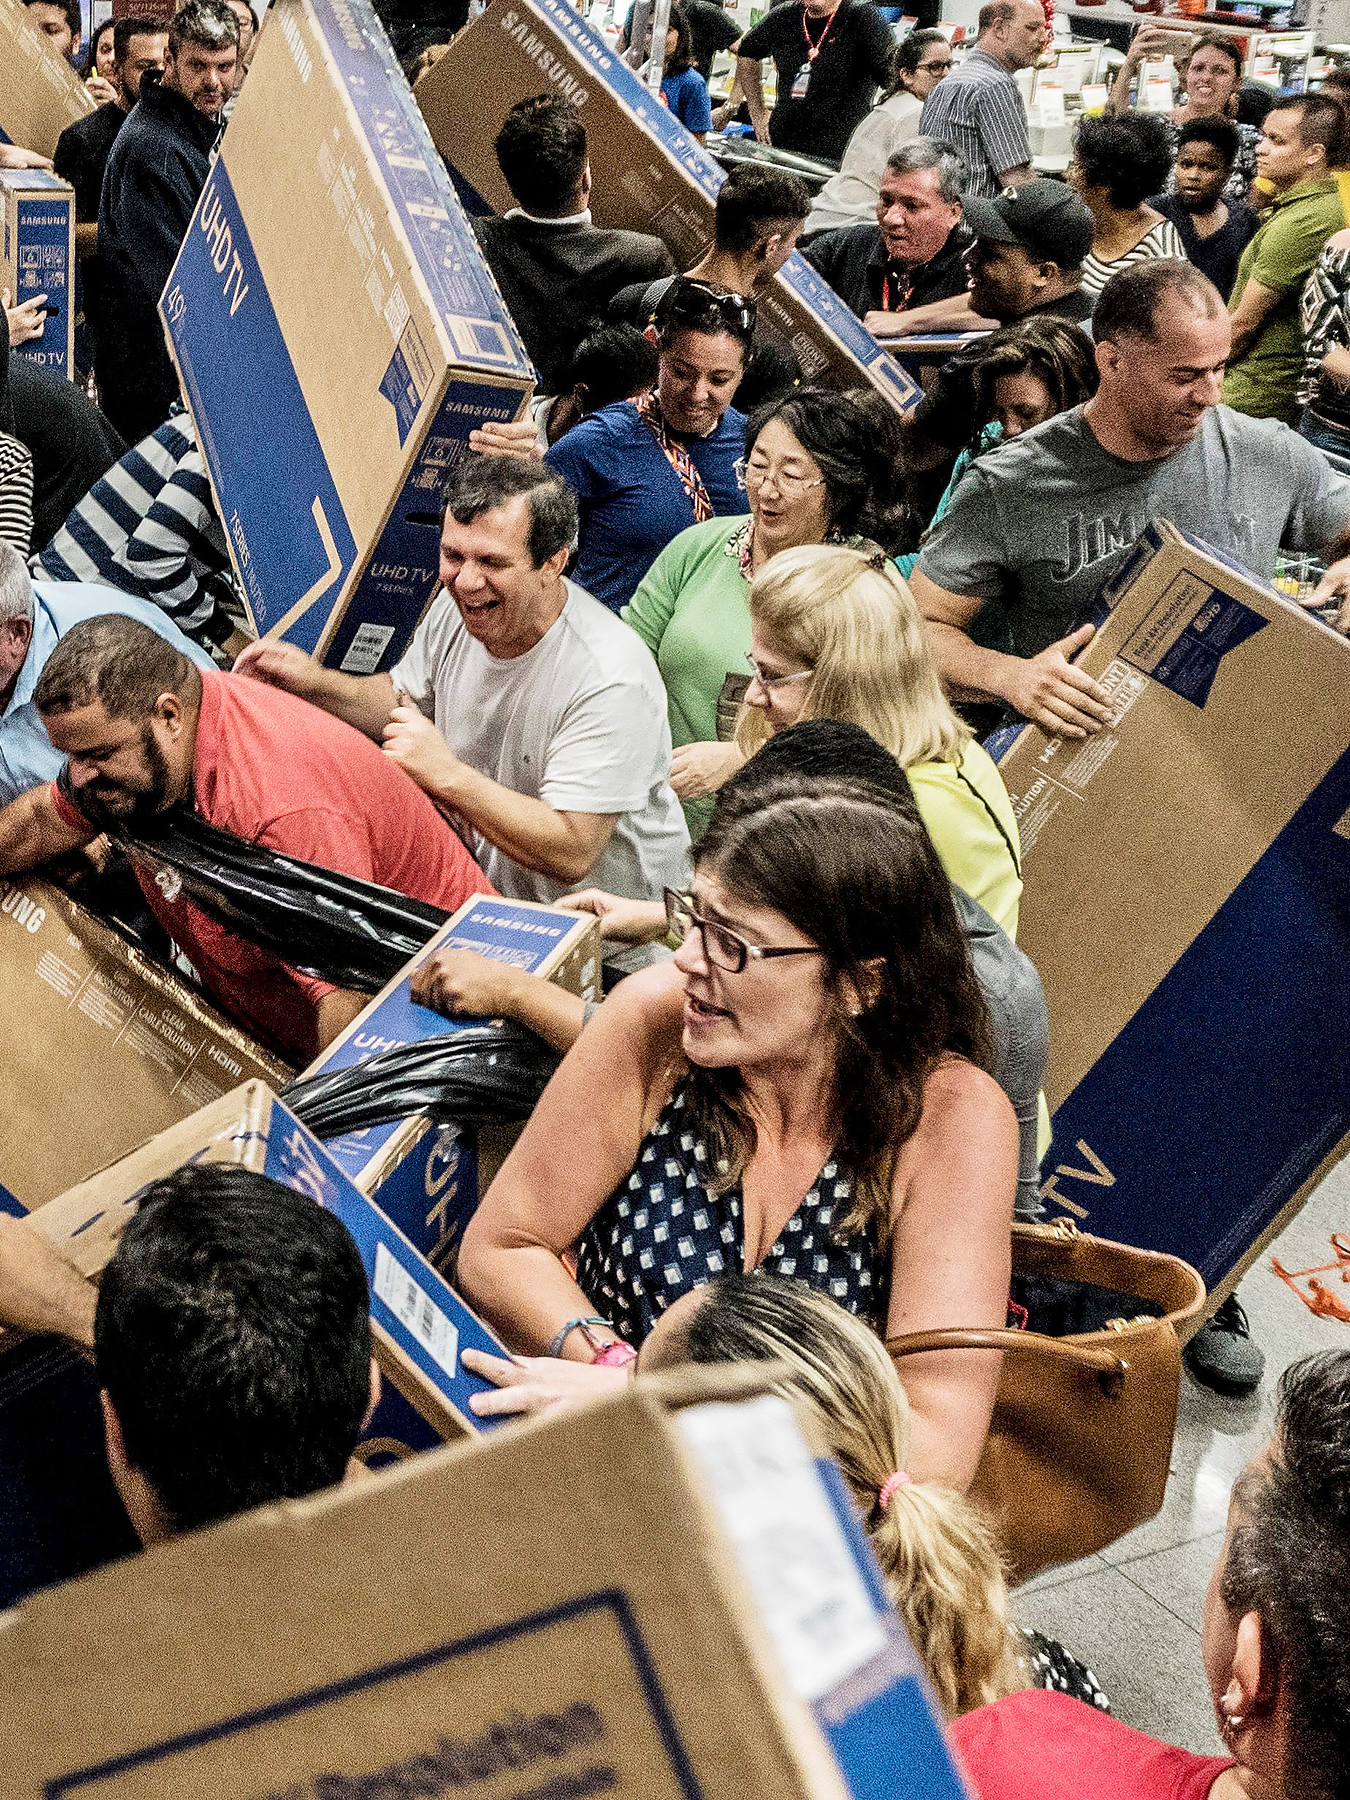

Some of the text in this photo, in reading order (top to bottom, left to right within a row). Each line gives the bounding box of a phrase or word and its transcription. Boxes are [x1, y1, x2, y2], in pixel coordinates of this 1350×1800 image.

[546, 0, 612, 70] AMSUNG
[500, 10, 589, 107] SAMSUNG
[20, 216, 67, 226] SAMSUNG
[446, 402, 510, 419] SAMSUNG
[1014, 777, 1048, 819] OLUTION
[469, 913, 563, 938] SAMSUNG
[158, 1022, 196, 1057] SOLUTION
[353, 1033, 403, 1051] UH
[1039, 1138, 1117, 1219] TV
